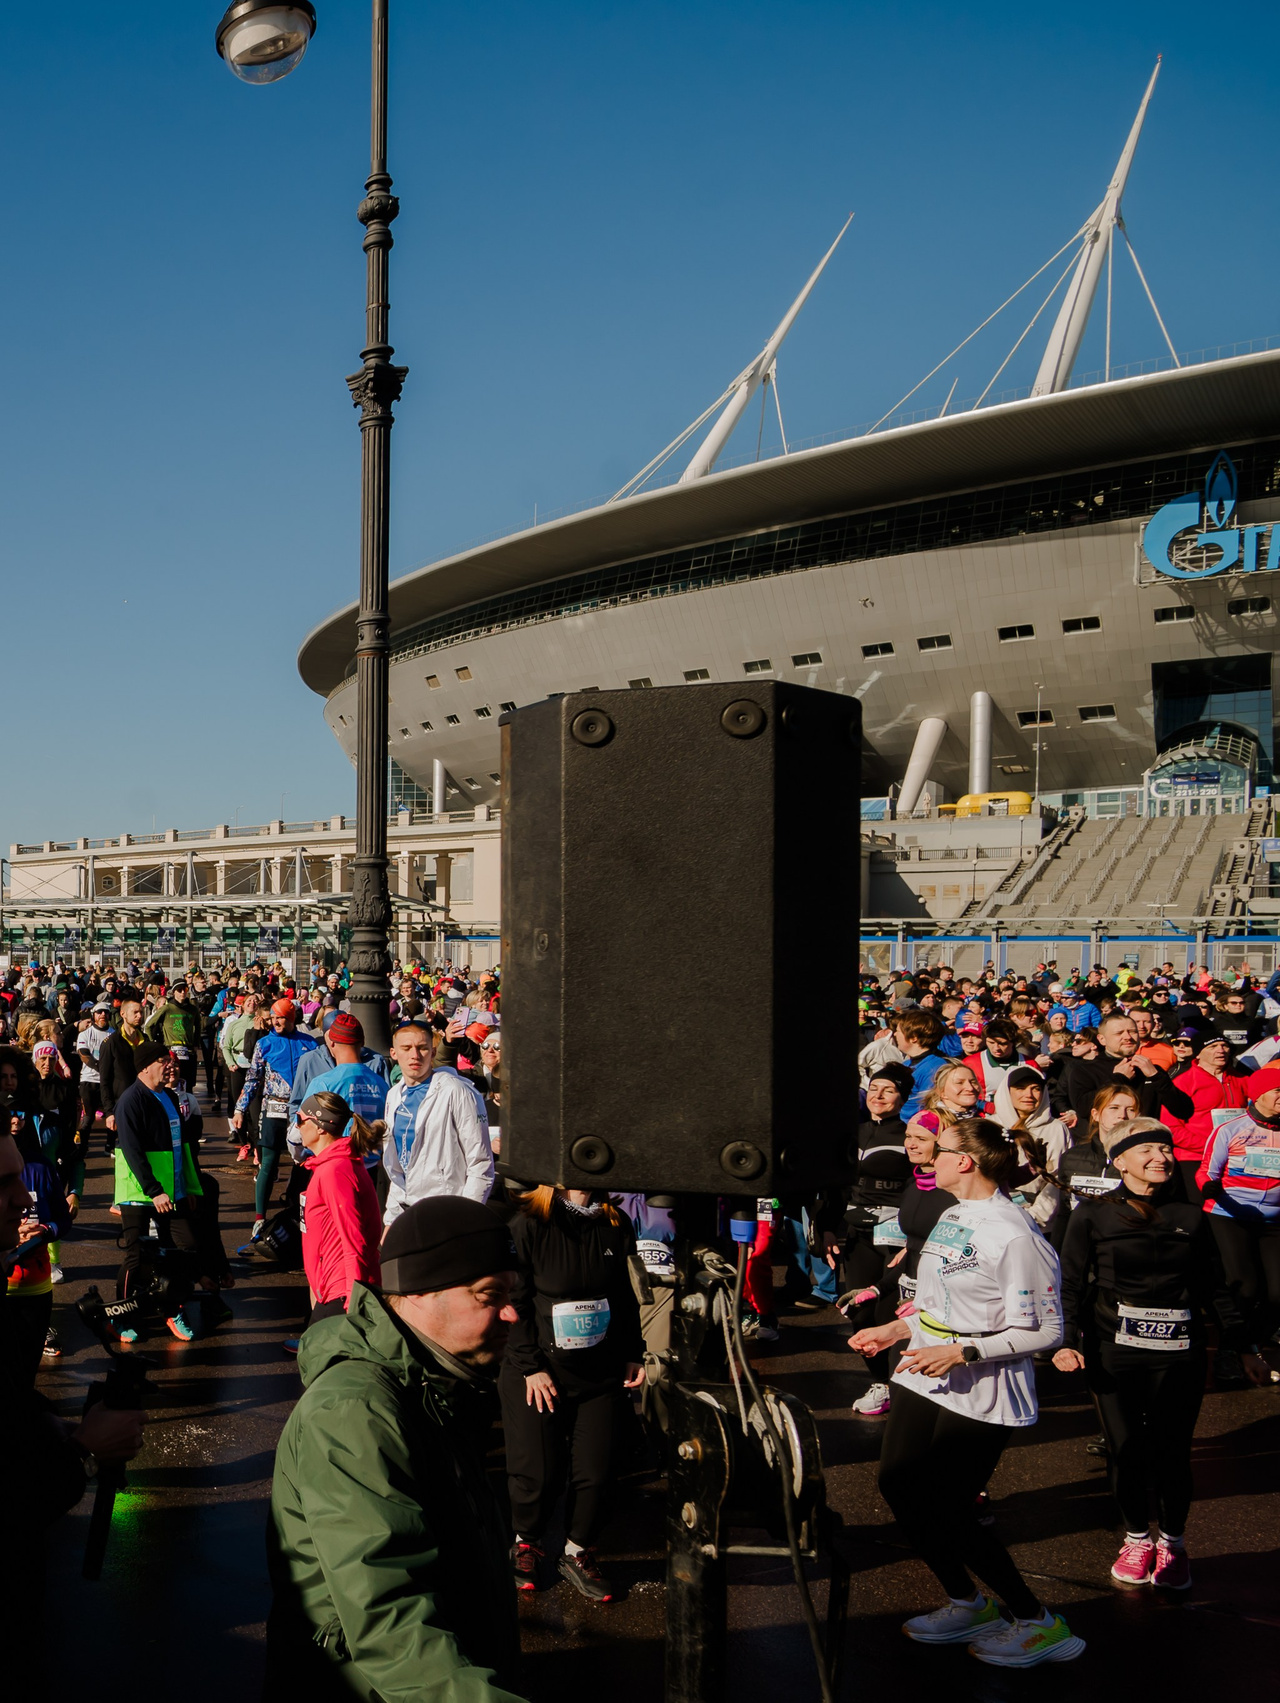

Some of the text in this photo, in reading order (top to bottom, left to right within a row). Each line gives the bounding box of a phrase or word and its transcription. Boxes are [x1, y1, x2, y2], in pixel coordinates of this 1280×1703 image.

[1199, 788, 1218, 796] 220
[69, 930, 77, 940] 4
[162, 929, 171, 940] 4
[264, 929, 273, 940] 4
[349, 1083, 381, 1094] АРЕНА
[1261, 1156, 1280, 1165] 120
[887, 1224, 901, 1233] 10
[942, 1261, 980, 1276] МАРАФОН
[104, 1300, 139, 1317] RONIN
[573, 1315, 599, 1329] 1154
[1136, 1321, 1176, 1334] 3787
